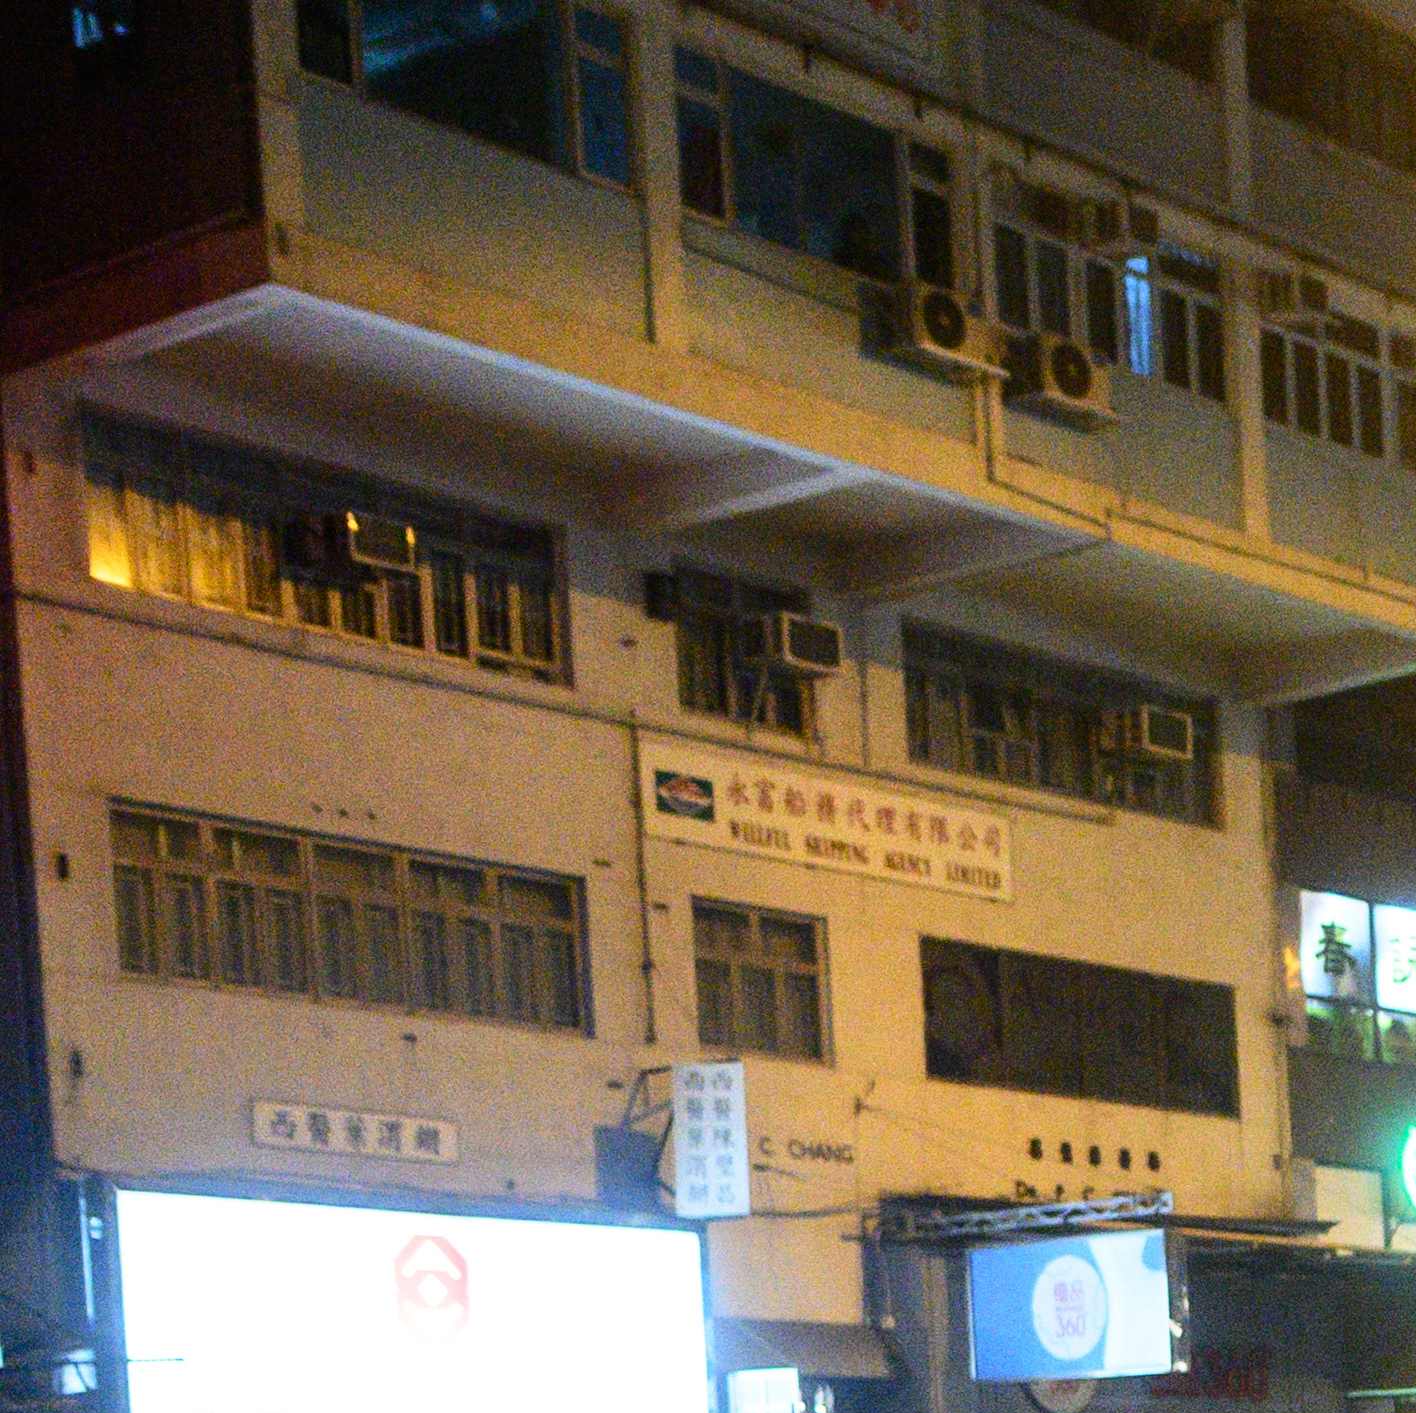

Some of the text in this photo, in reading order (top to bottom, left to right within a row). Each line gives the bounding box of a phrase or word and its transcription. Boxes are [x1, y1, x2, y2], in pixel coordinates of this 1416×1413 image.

[804, 833, 870, 865] SHIPPING
[884, 850, 932, 878] AGENCY
[945, 862, 1002, 890] LIMITED
[1056, 1313, 1087, 1339] 360
